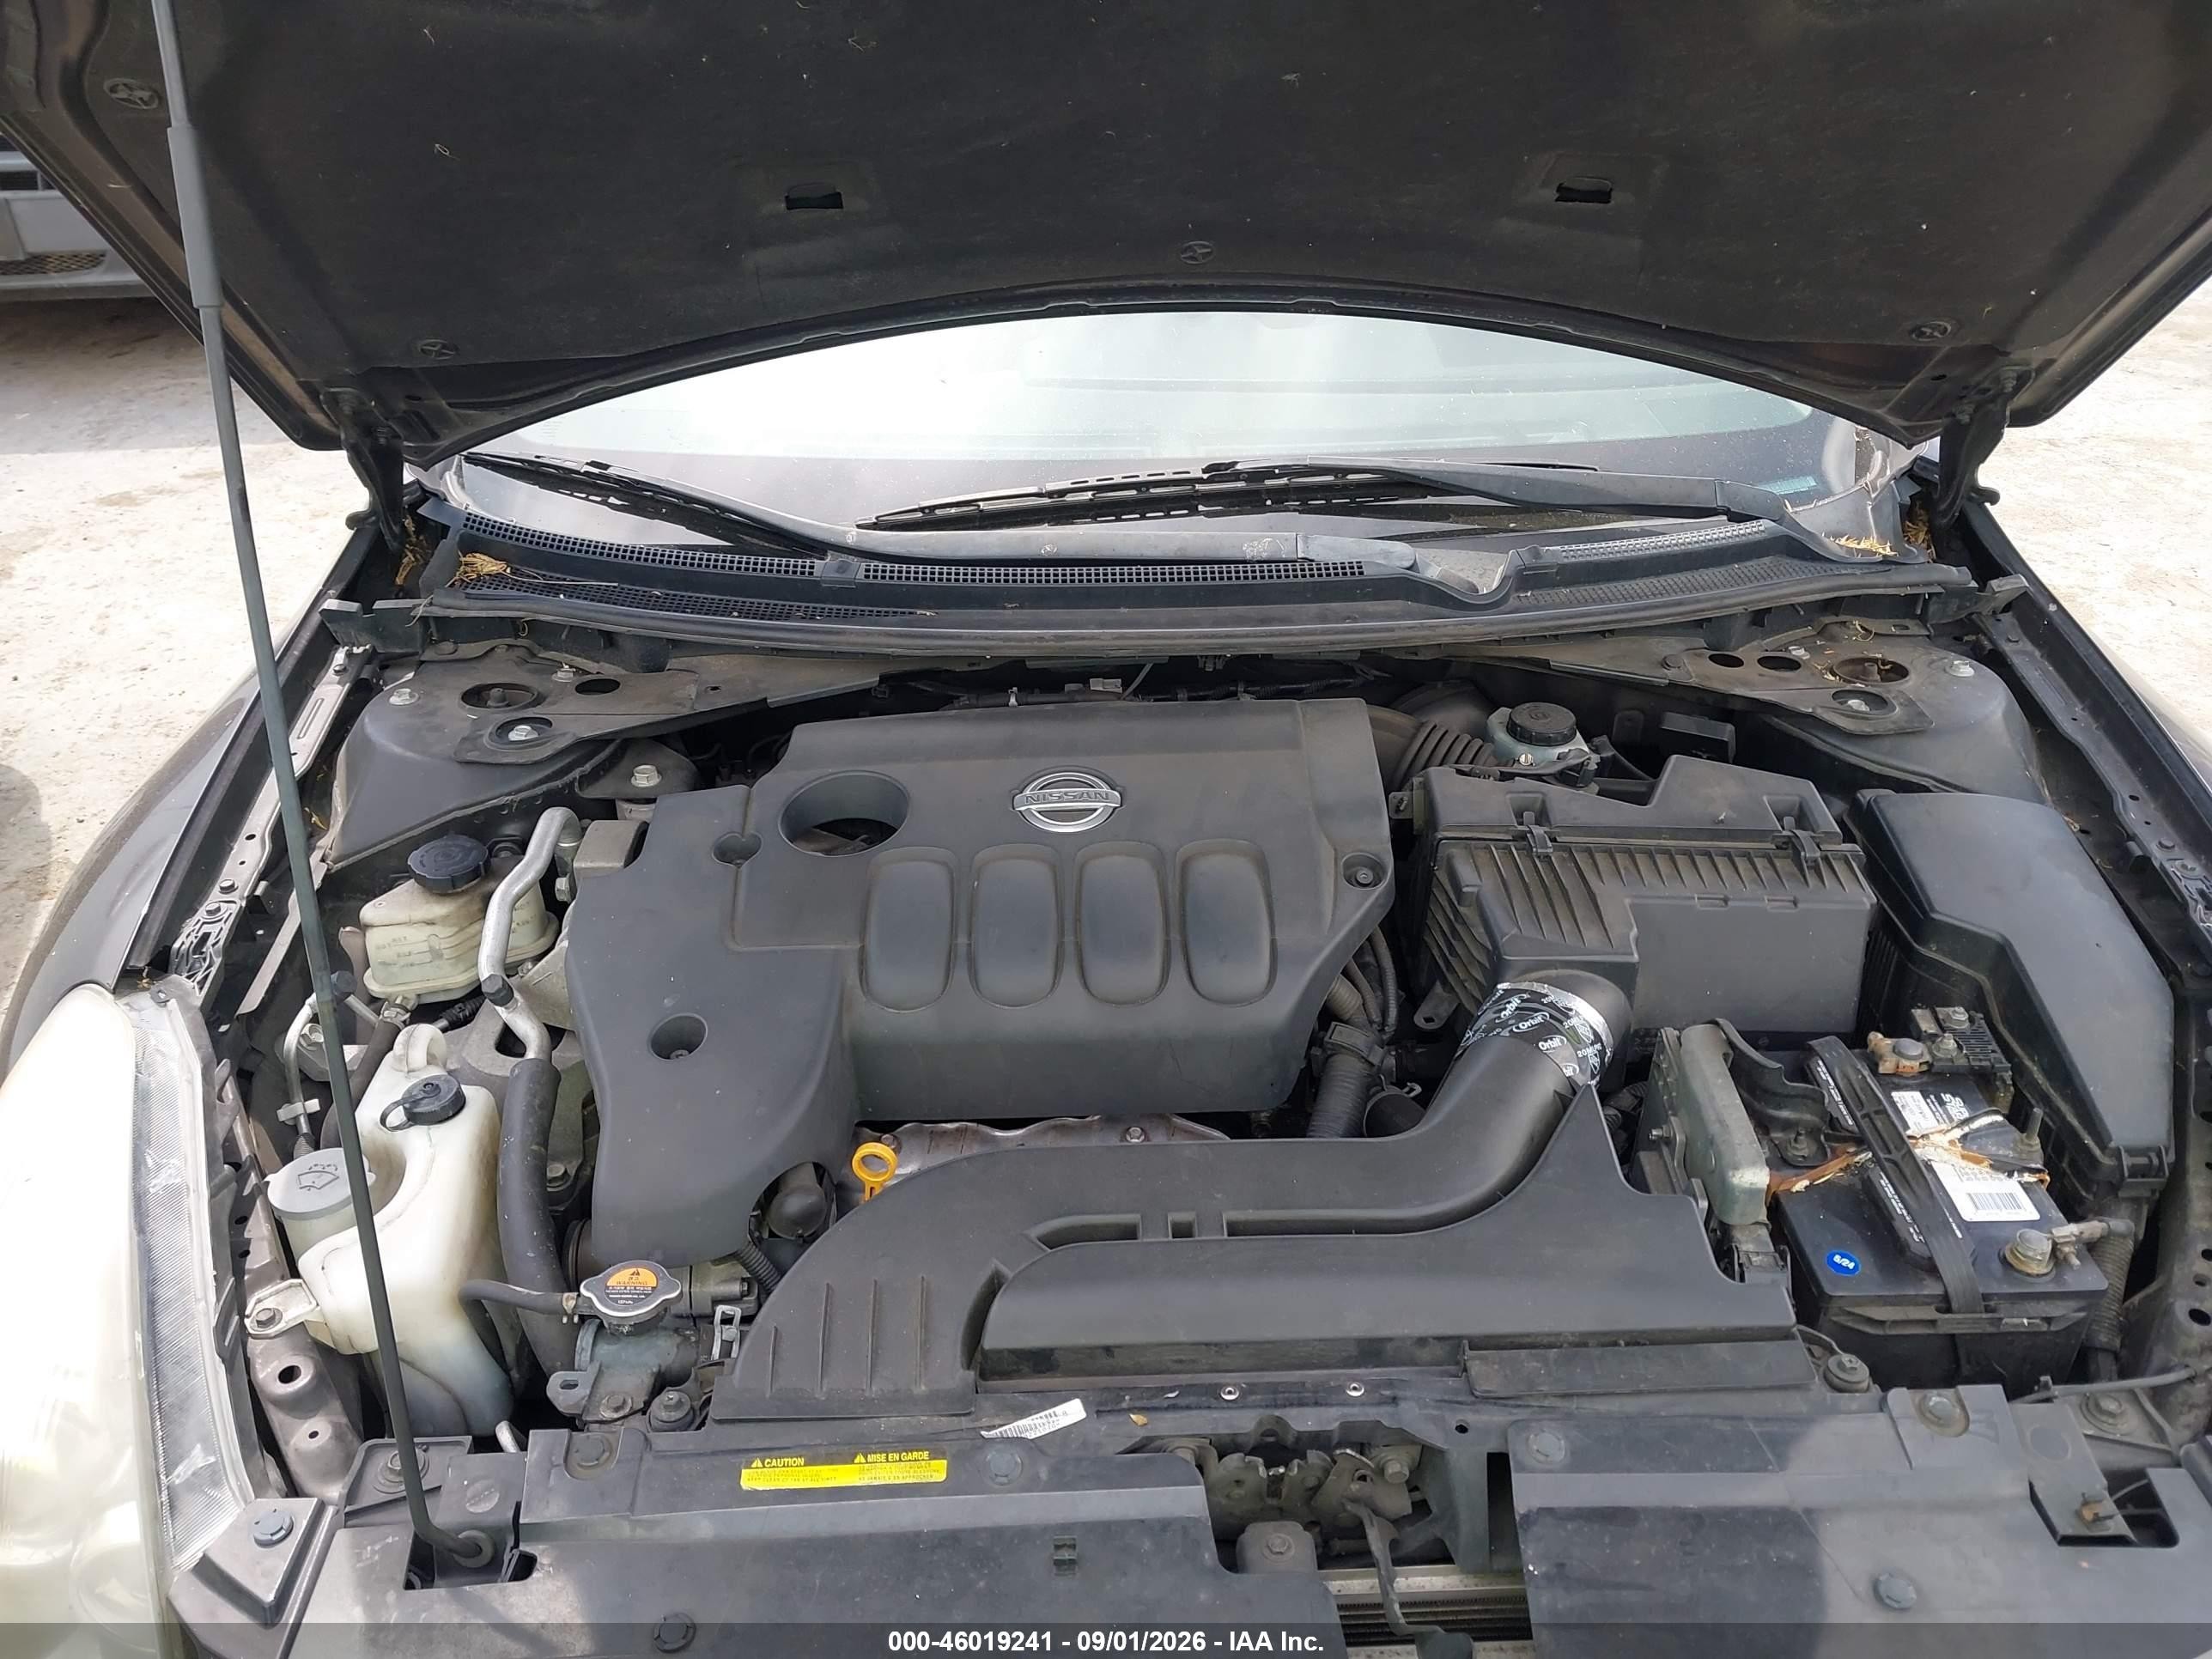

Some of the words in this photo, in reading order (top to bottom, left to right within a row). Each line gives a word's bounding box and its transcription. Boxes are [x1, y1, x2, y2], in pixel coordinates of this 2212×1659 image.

[1025, 791, 1110, 805] NISSAN
[1501, 998, 1522, 1018] Orbit
[1518, 1015, 1545, 1029] Orbit
[1538, 1037, 1563, 1050] Orbit
[764, 1457, 805, 1468] CAUTION
[867, 1453, 886, 1462] MISE
[888, 1452, 900, 1462] EN
[901, 1451, 930, 1461] GARDE
